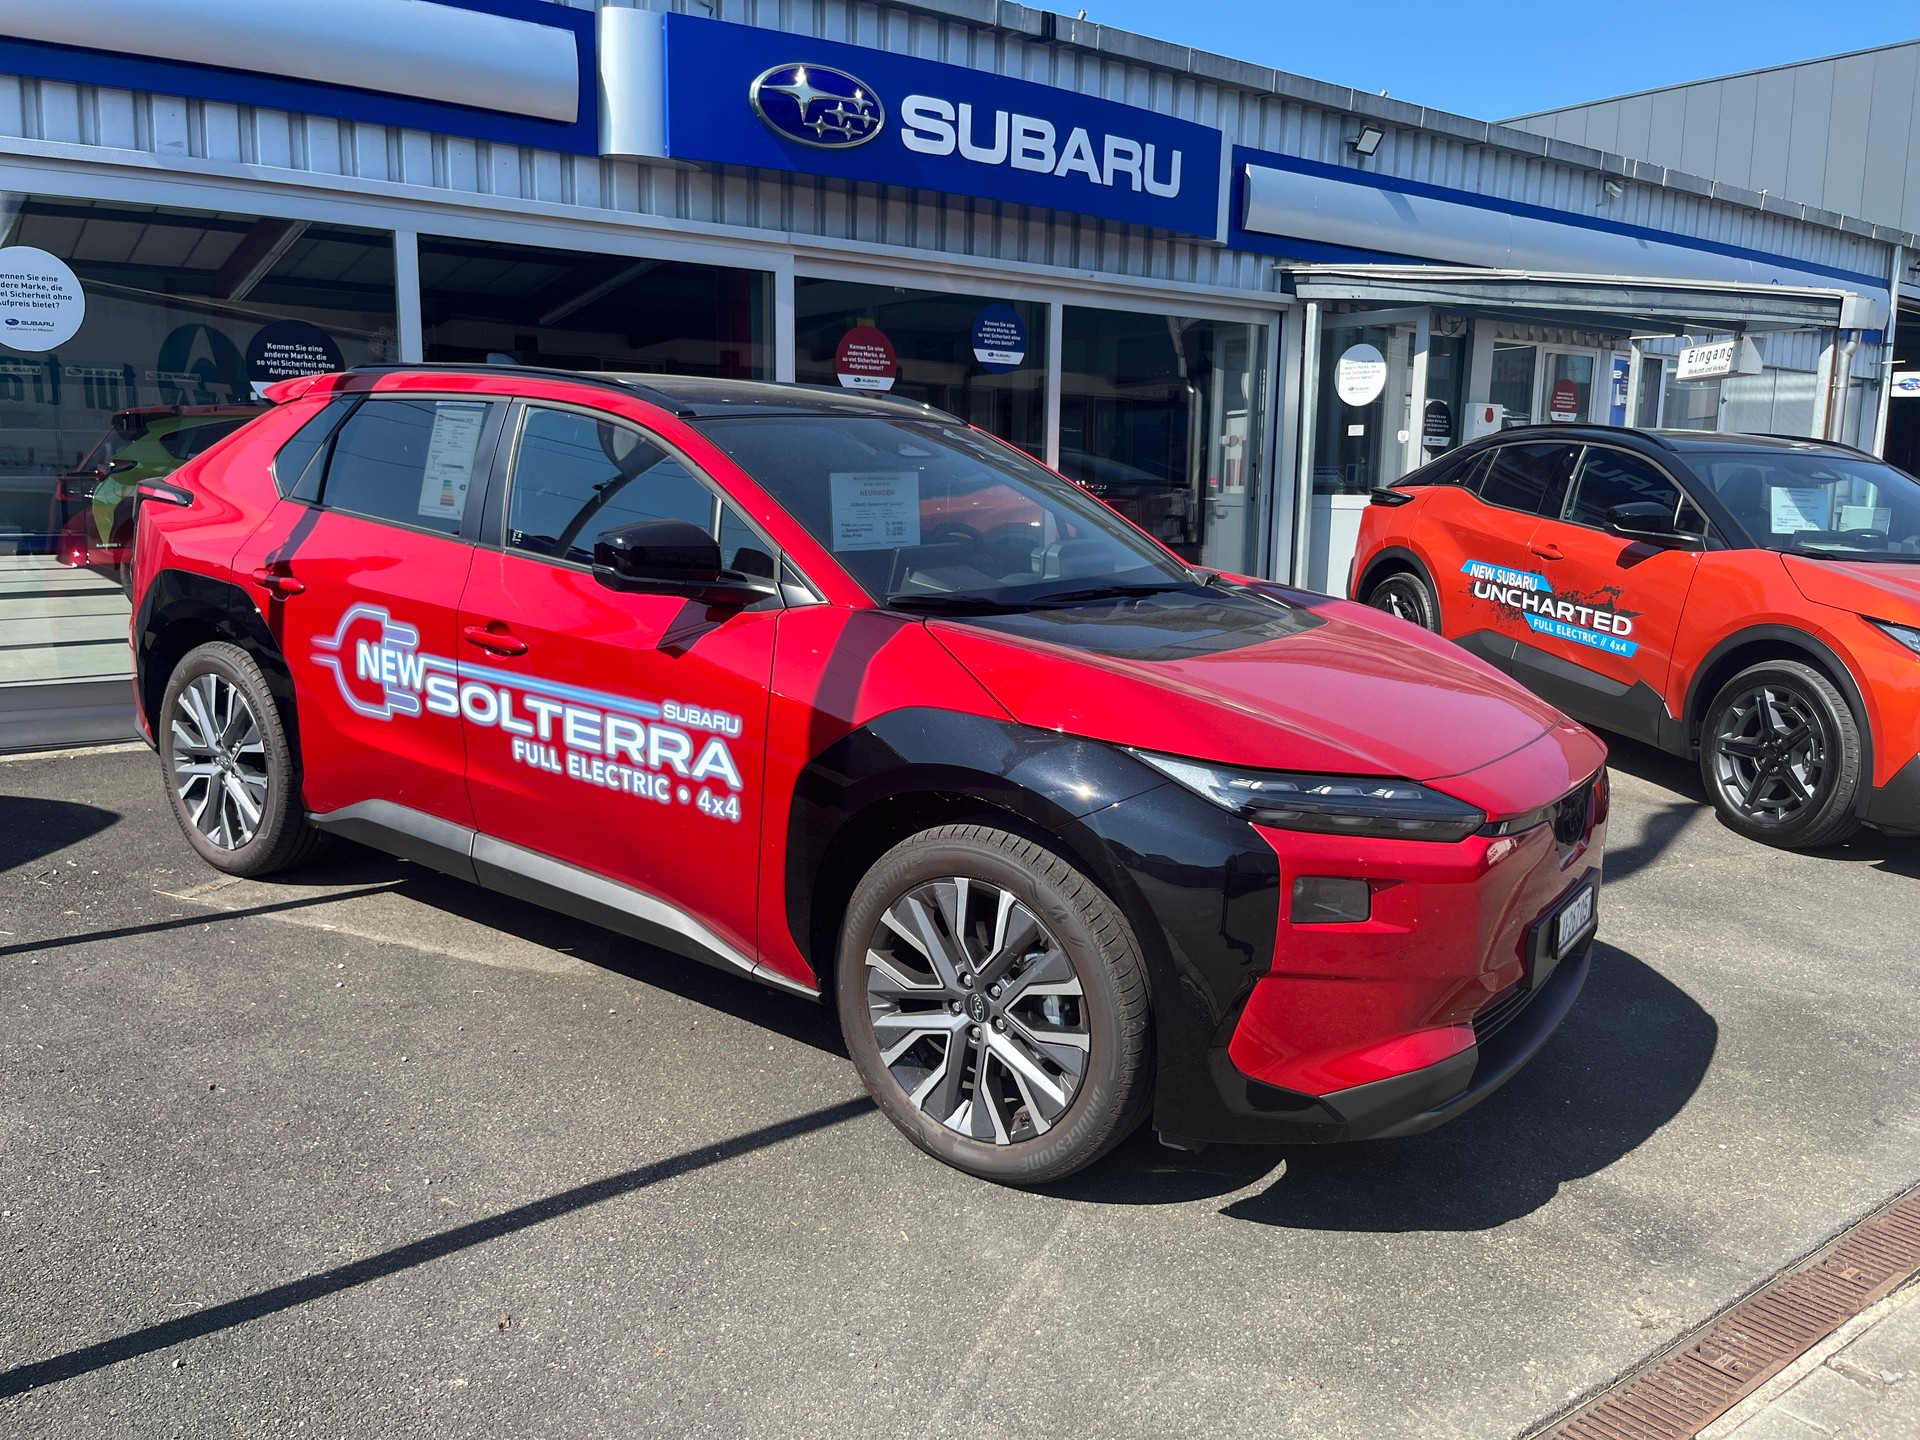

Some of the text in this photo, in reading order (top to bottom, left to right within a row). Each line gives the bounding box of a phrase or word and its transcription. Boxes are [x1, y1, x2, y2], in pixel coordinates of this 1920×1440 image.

[902, 94, 1182, 198] SUBARU
[0, 273, 25, 281] ennen
[21, 283, 49, 292] Marke,
[51, 284, 63, 292] die
[10, 290, 51, 300] Sicherheit
[32, 300, 60, 309] bietet?
[267, 342, 294, 351] Kennen
[295, 344, 307, 352] Sie
[290, 352, 315, 361] Marke,
[1688, 347, 1733, 364] Eingang
[269, 367, 299, 376] Aufpreis
[281, 360, 317, 368] Sicherheit
[1470, 563, 1538, 592] NEW SUBARU
[1473, 580, 1632, 636] UNCHARTED
[1533, 618, 1554, 633] FULL
[1556, 622, 1598, 645] ELECTRIC
[1609, 640, 1627, 652] 4x4
[358, 643, 424, 690] NEW
[426, 675, 742, 788] SOLTERRA
[663, 704, 740, 734] SUBARU
[513, 740, 740, 820] FULL ELECTRIC 4x4
[844, 856, 920, 945] BRIDGESTONE
[1019, 1084, 1108, 1171] BRIDGESTONE
